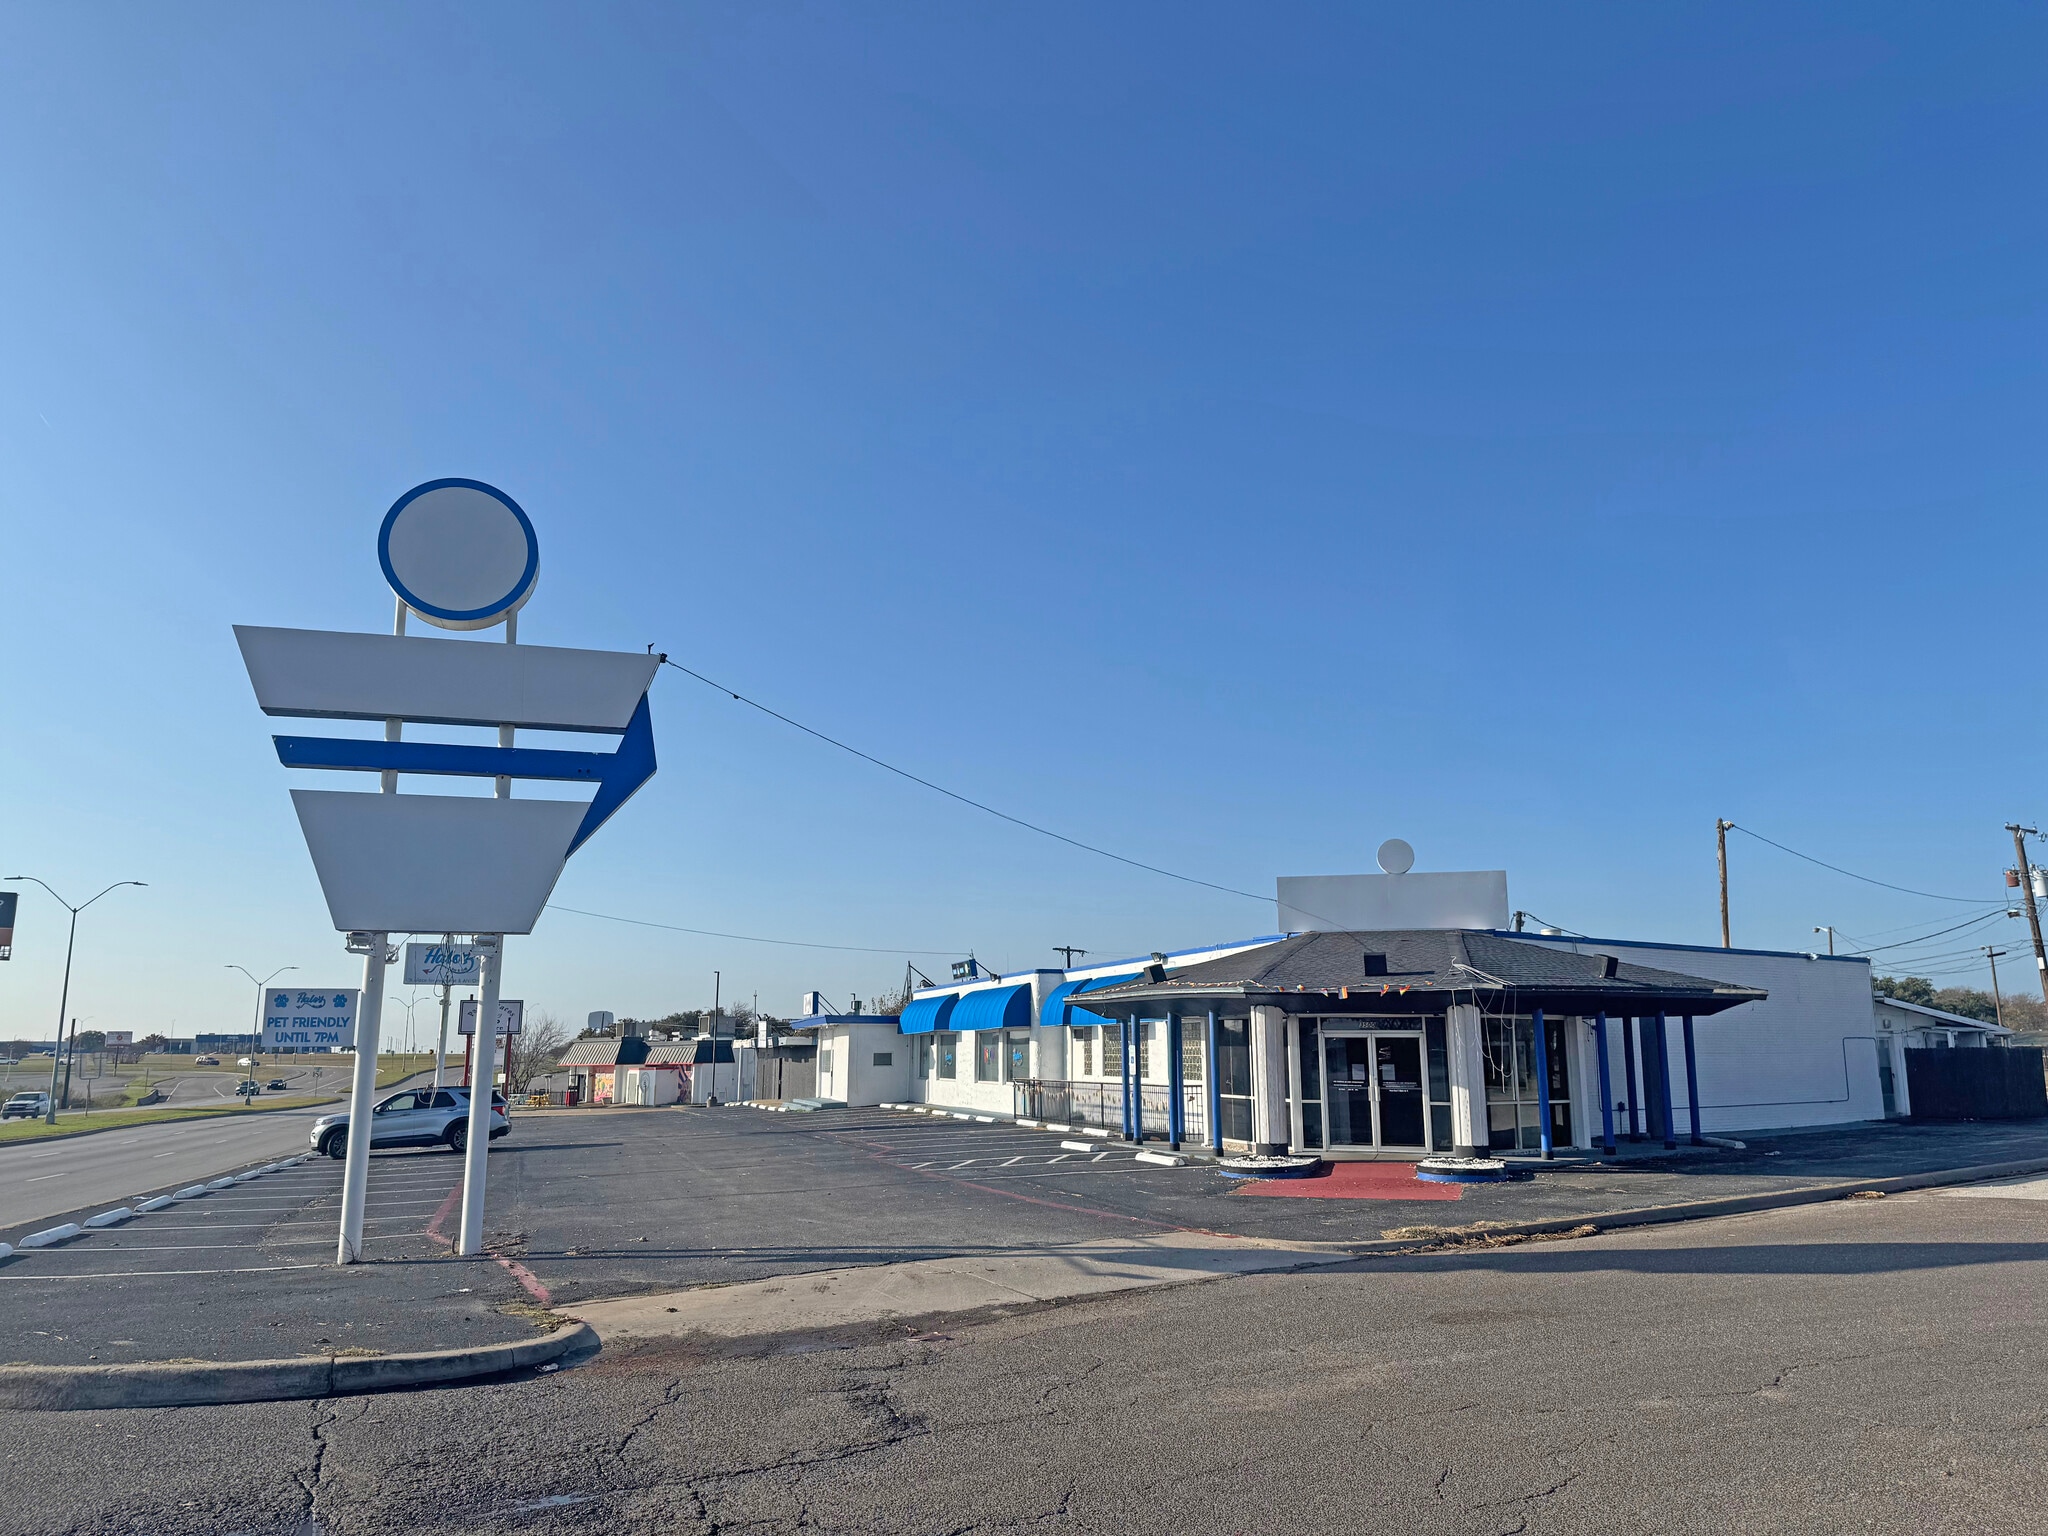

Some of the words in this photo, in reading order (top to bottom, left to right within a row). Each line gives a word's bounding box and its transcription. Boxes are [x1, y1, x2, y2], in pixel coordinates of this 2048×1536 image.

[266, 1016, 289, 1028] PET
[292, 1016, 350, 1028] FRIENDLY
[274, 1031, 310, 1043] UNTIL
[314, 1031, 339, 1043] 7PM
